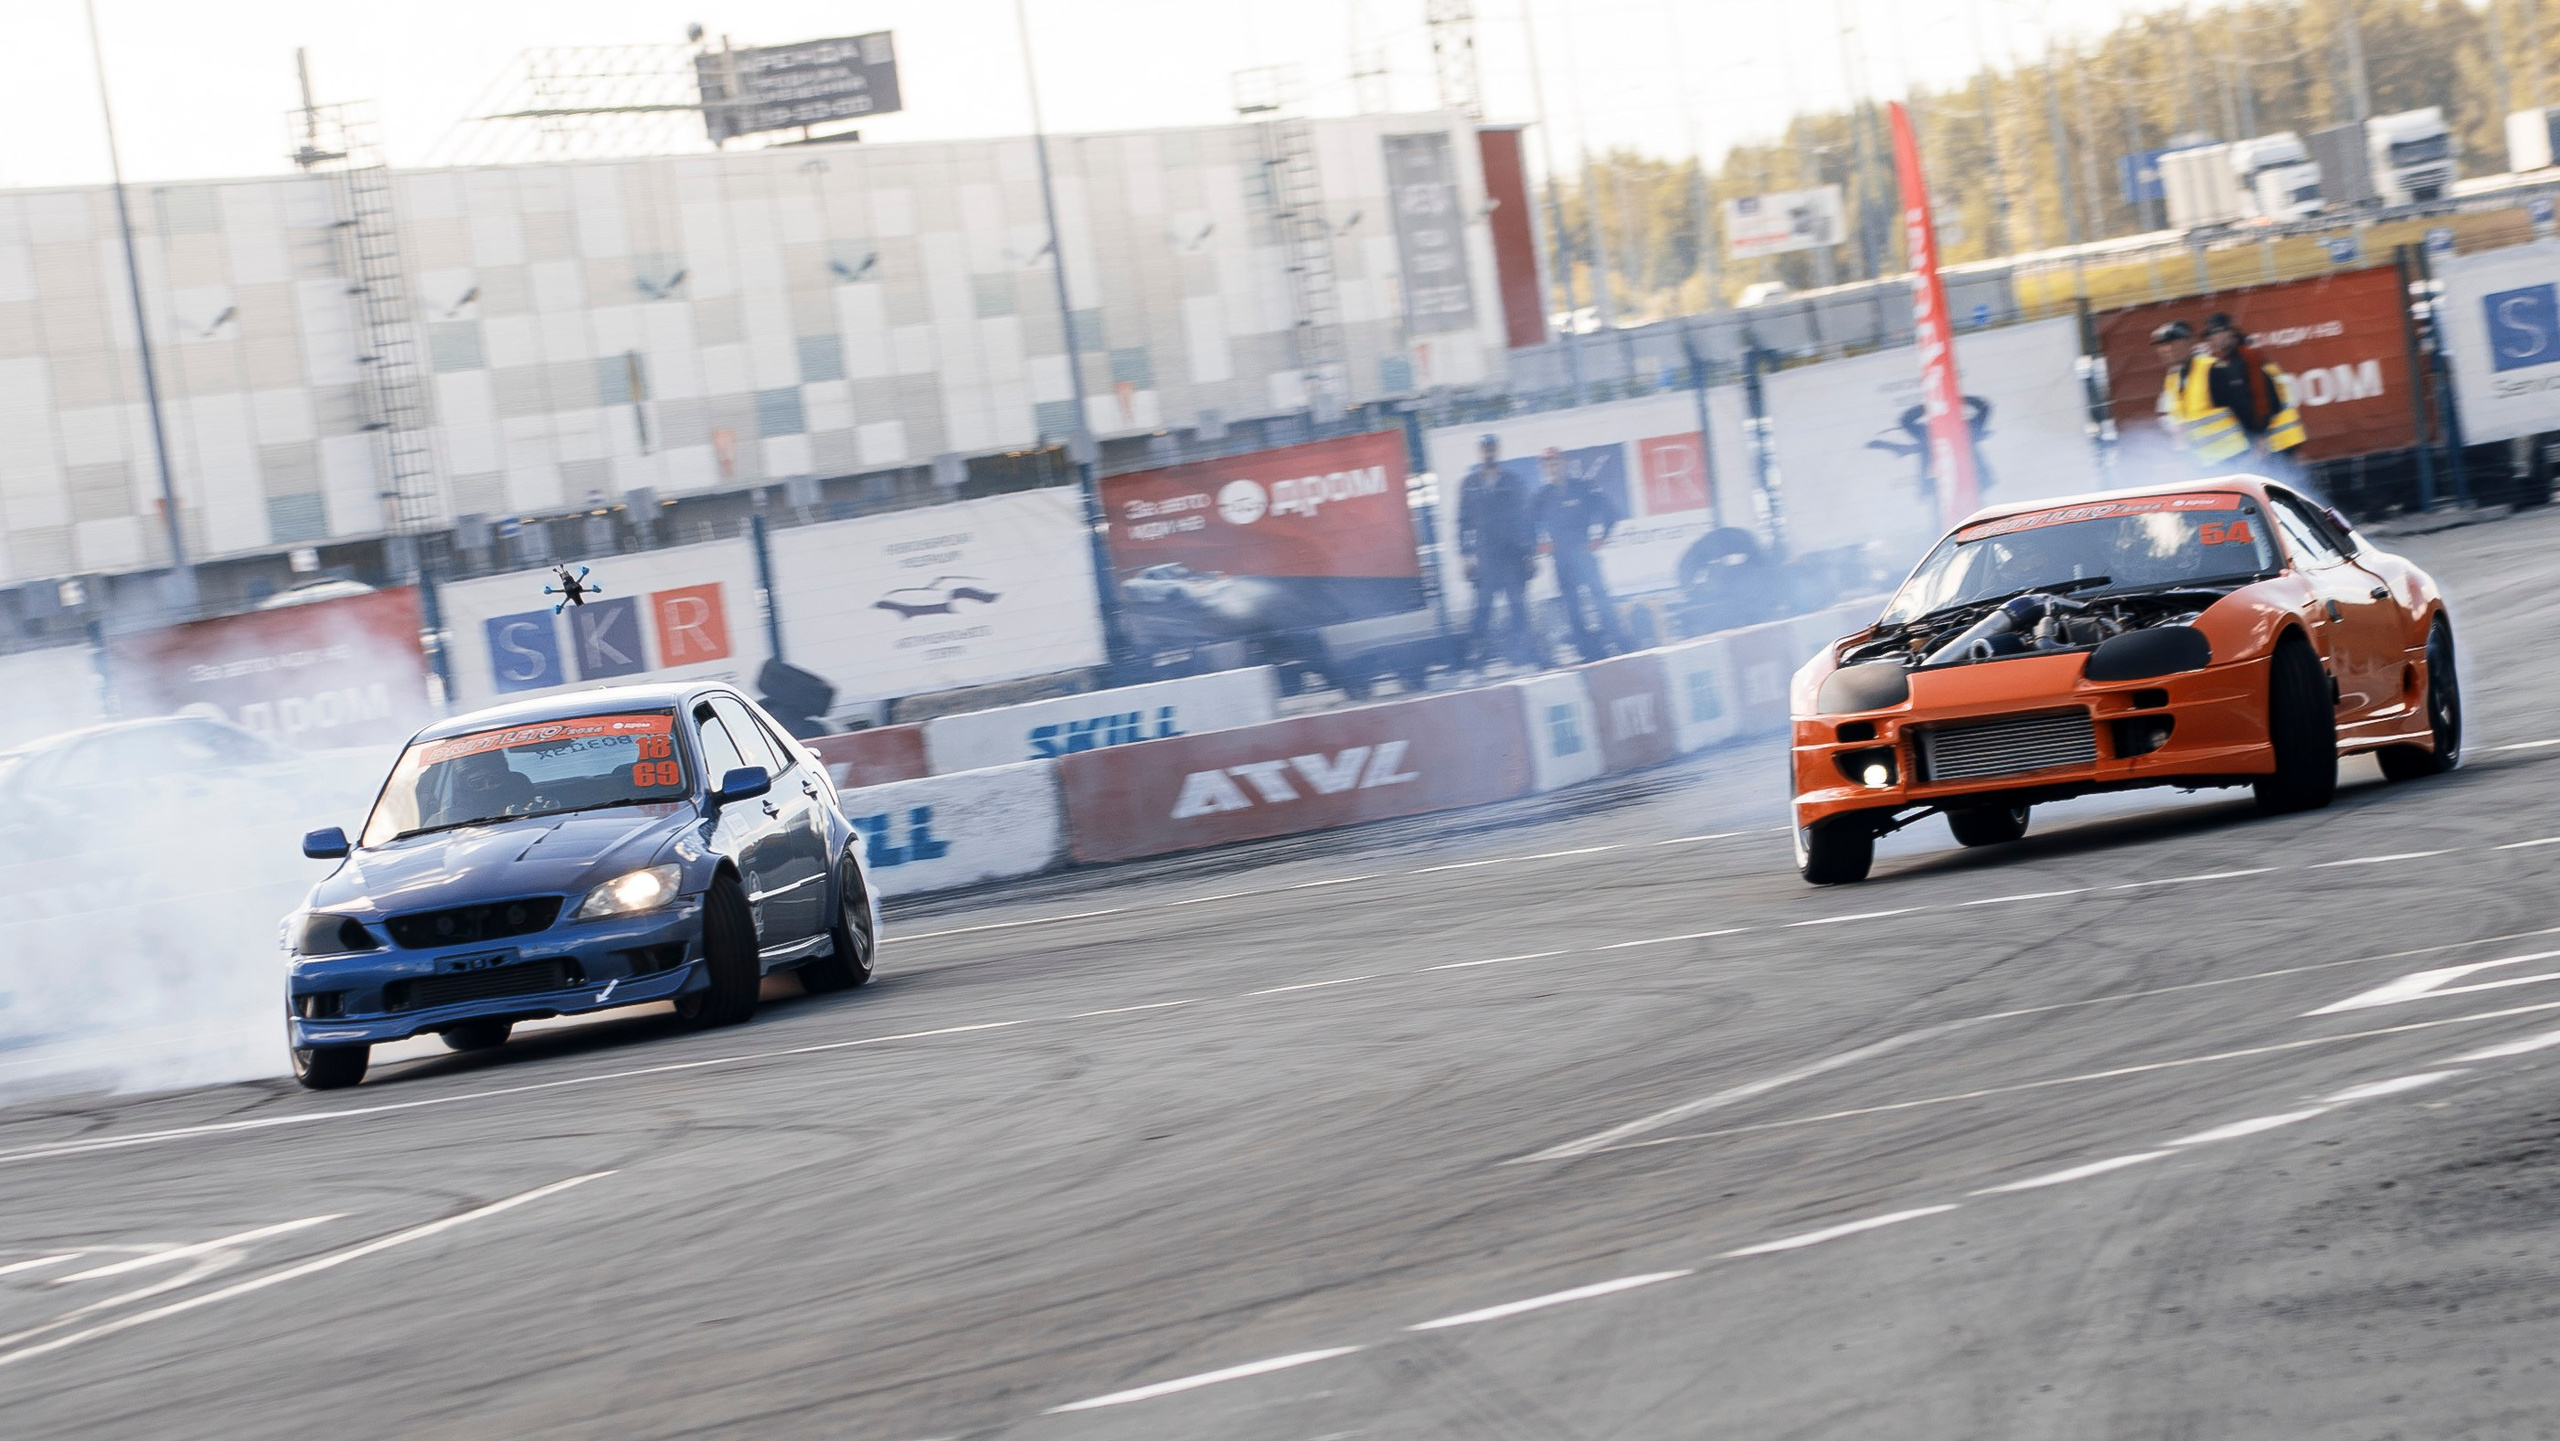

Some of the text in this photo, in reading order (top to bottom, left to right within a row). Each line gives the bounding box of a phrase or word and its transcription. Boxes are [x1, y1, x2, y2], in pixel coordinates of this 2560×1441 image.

[2201, 521, 2255, 546] 54
[500, 596, 718, 681] SKR
[427, 734, 501, 762] DRIFT
[500, 725, 563, 745] LETO
[635, 735, 672, 760] 18
[1026, 705, 1187, 759] SKILL
[632, 761, 679, 787] 69
